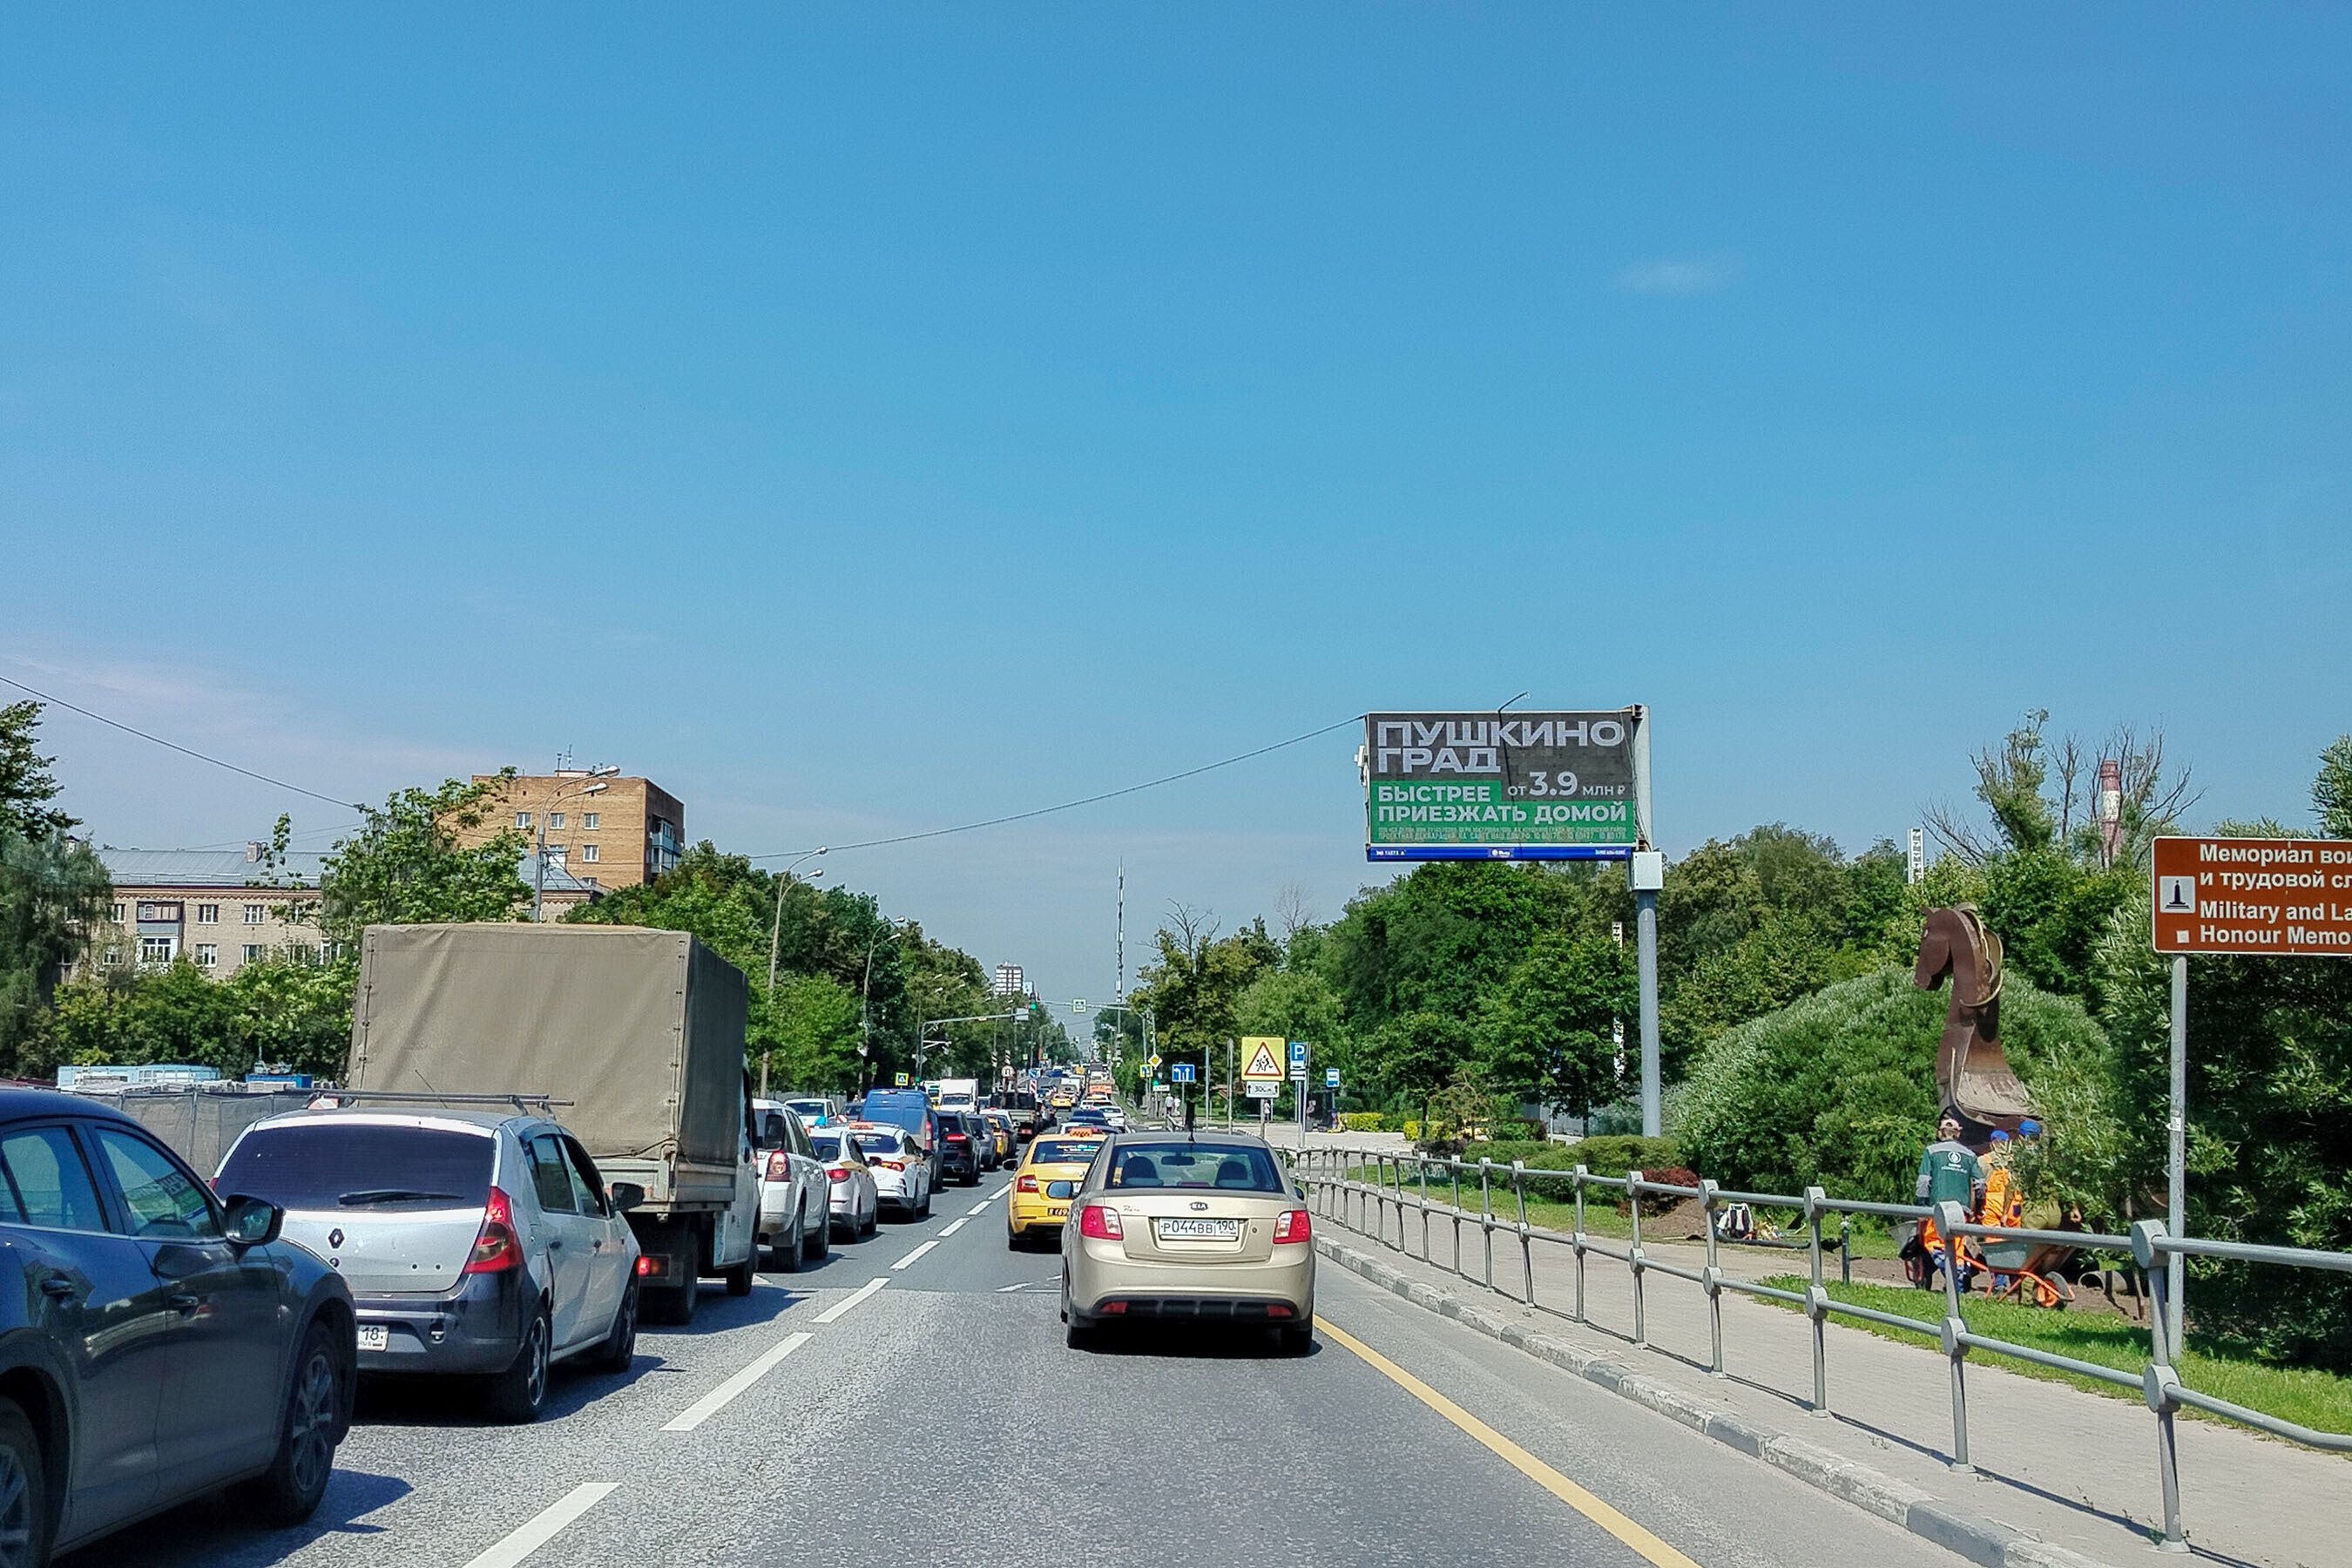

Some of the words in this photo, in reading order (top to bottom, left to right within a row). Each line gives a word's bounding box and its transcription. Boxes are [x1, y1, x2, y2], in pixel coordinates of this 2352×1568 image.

[1378, 721, 1625, 747] ПУШКИНО
[1378, 747, 1501, 774] ГРАД
[1378, 786, 1491, 802] БЫСТРЕЕ
[1529, 771, 1578, 796] 3.9
[1378, 805, 1527, 822] ПРИЕЗЖАТЬ
[1534, 801, 1627, 825] ДОМОЙ
[2200, 843, 2314, 867] Мемориал
[2200, 872, 2213, 886] и
[2220, 870, 2325, 891] трудовой
[2200, 901, 2280, 924] Military
[2286, 902, 2325, 921] and
[2331, 903, 2352, 922] La
[2200, 925, 2281, 944] Honour
[2287, 926, 2352, 945] Memo
[362, 1327, 380, 1341] 18
